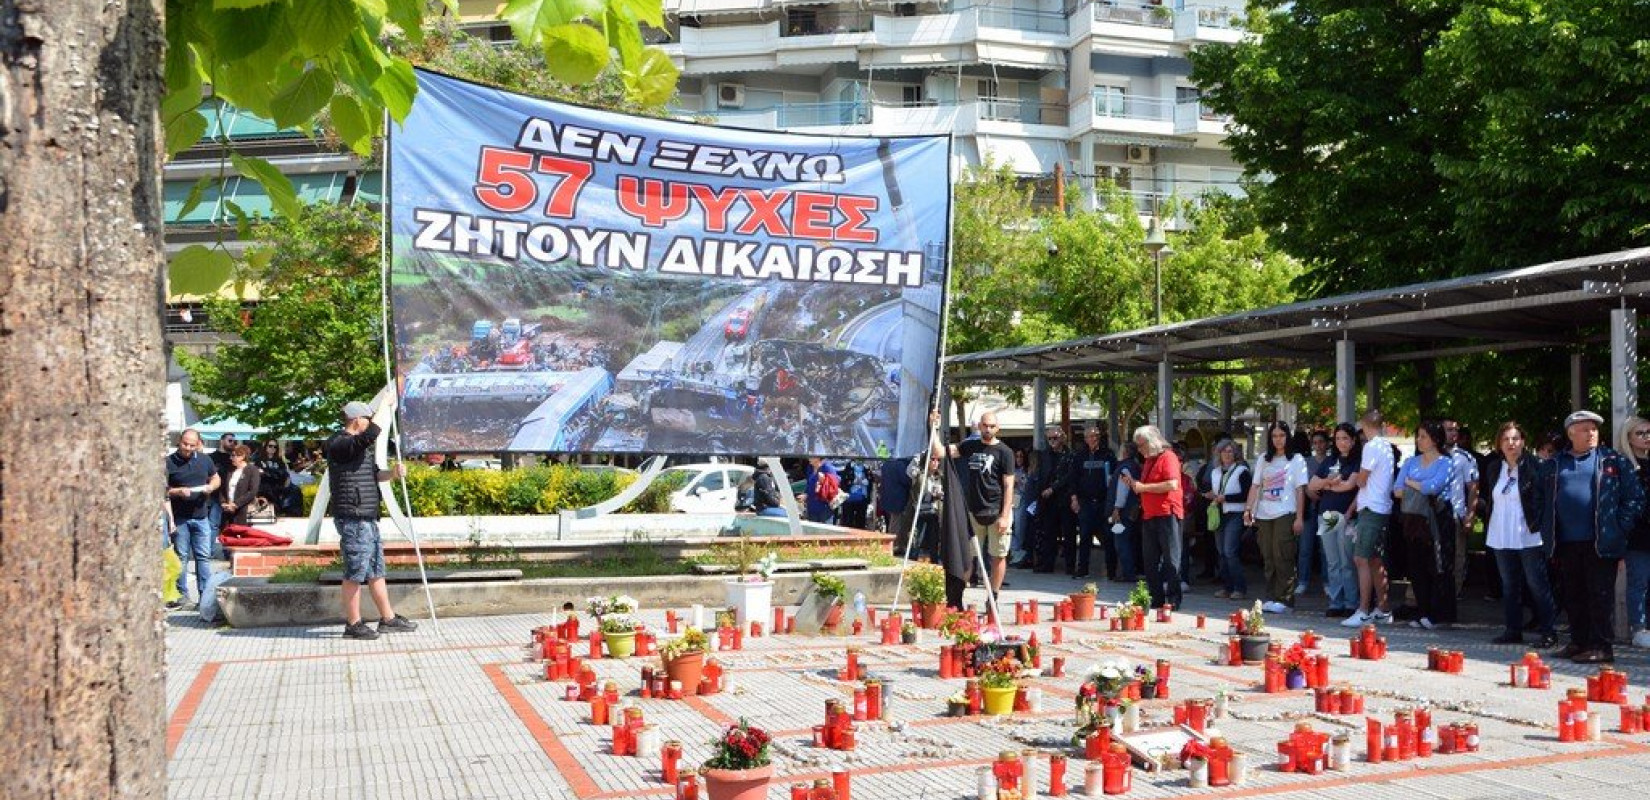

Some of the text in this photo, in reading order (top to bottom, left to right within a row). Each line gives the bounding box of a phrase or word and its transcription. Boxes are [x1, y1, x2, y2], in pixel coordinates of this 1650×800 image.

[517, 117, 844, 183] ΔΕΝ ΞΕΧΝΩ
[475, 147, 878, 242] 57 ΨΥΧΕΣ
[413, 209, 924, 286] ΖΗΤΟΥΝ ΔΙΚΑΙΩΣΗ
